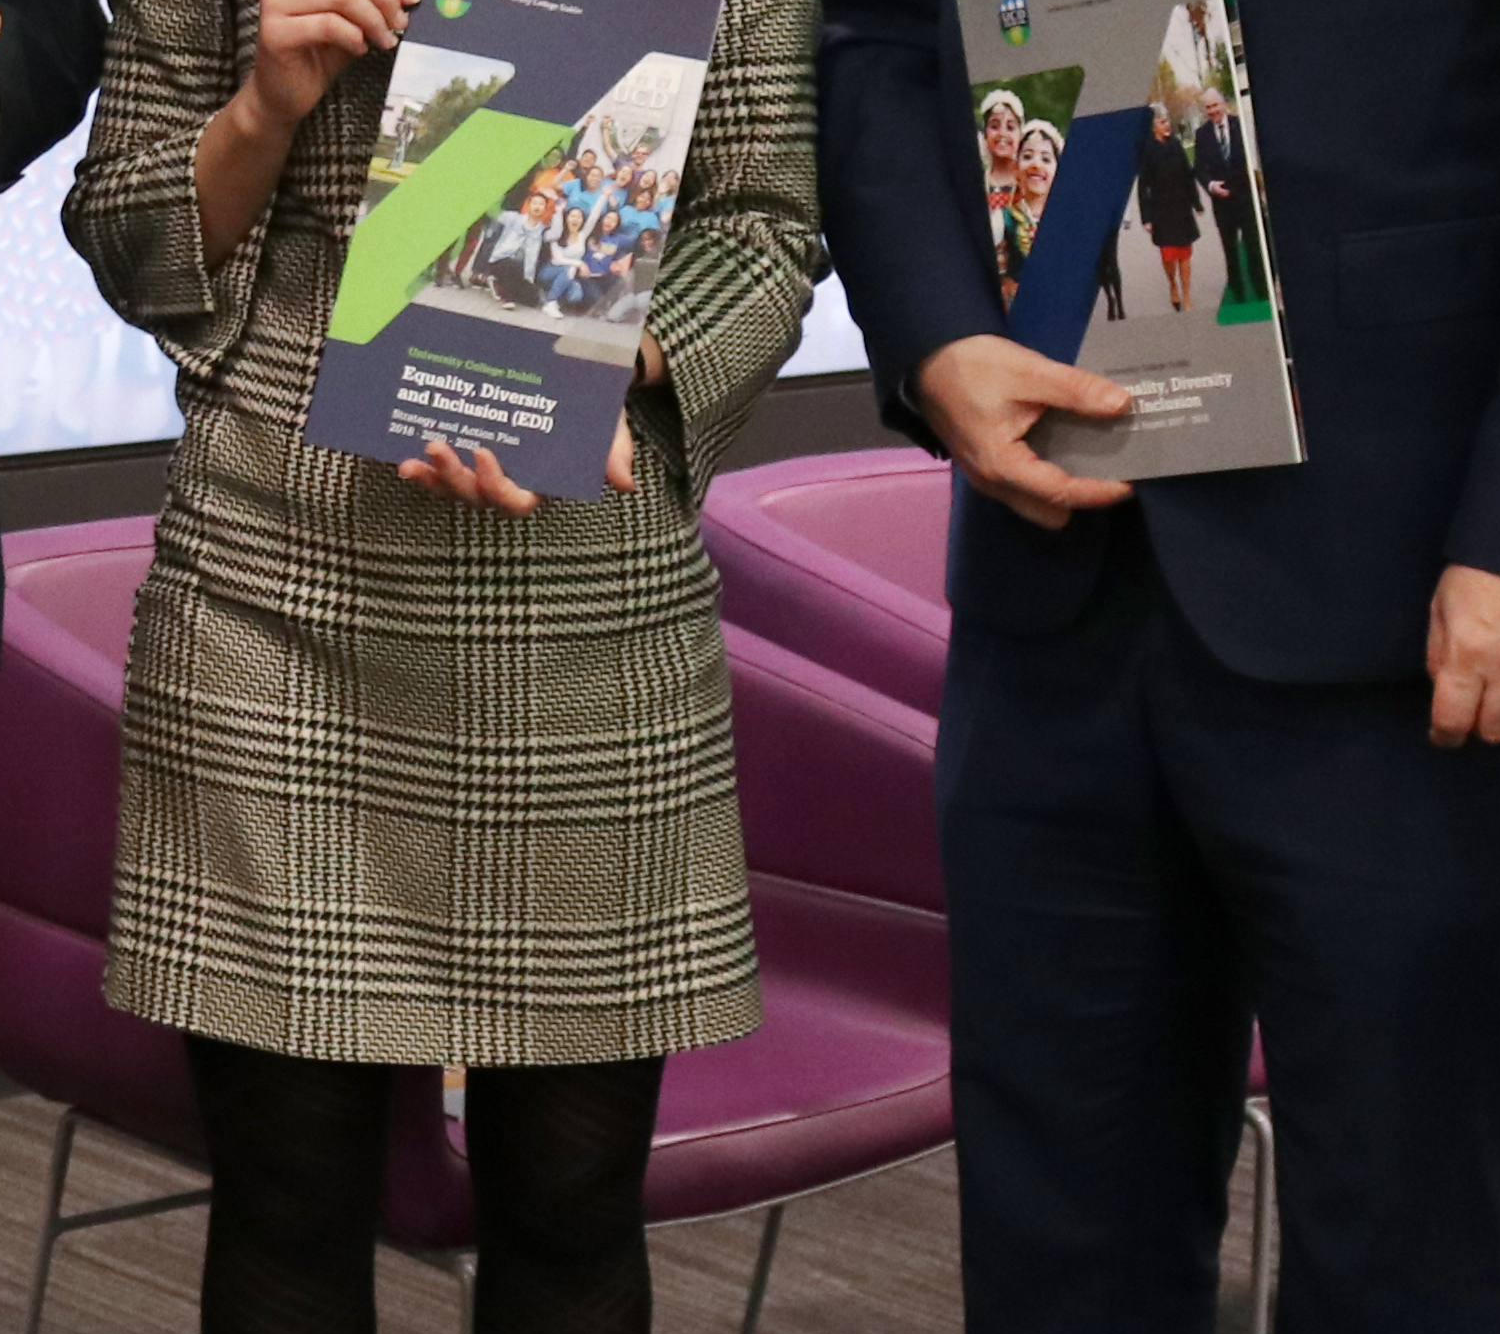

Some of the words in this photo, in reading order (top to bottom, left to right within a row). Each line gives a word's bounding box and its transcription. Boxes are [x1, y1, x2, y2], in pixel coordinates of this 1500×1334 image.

[397, 386, 429, 406] and
[432, 392, 509, 423] Inclusion
[511, 410, 554, 434] (EDI)
[402, 365, 477, 397] Equality,
[480, 382, 558, 413] Diversity
